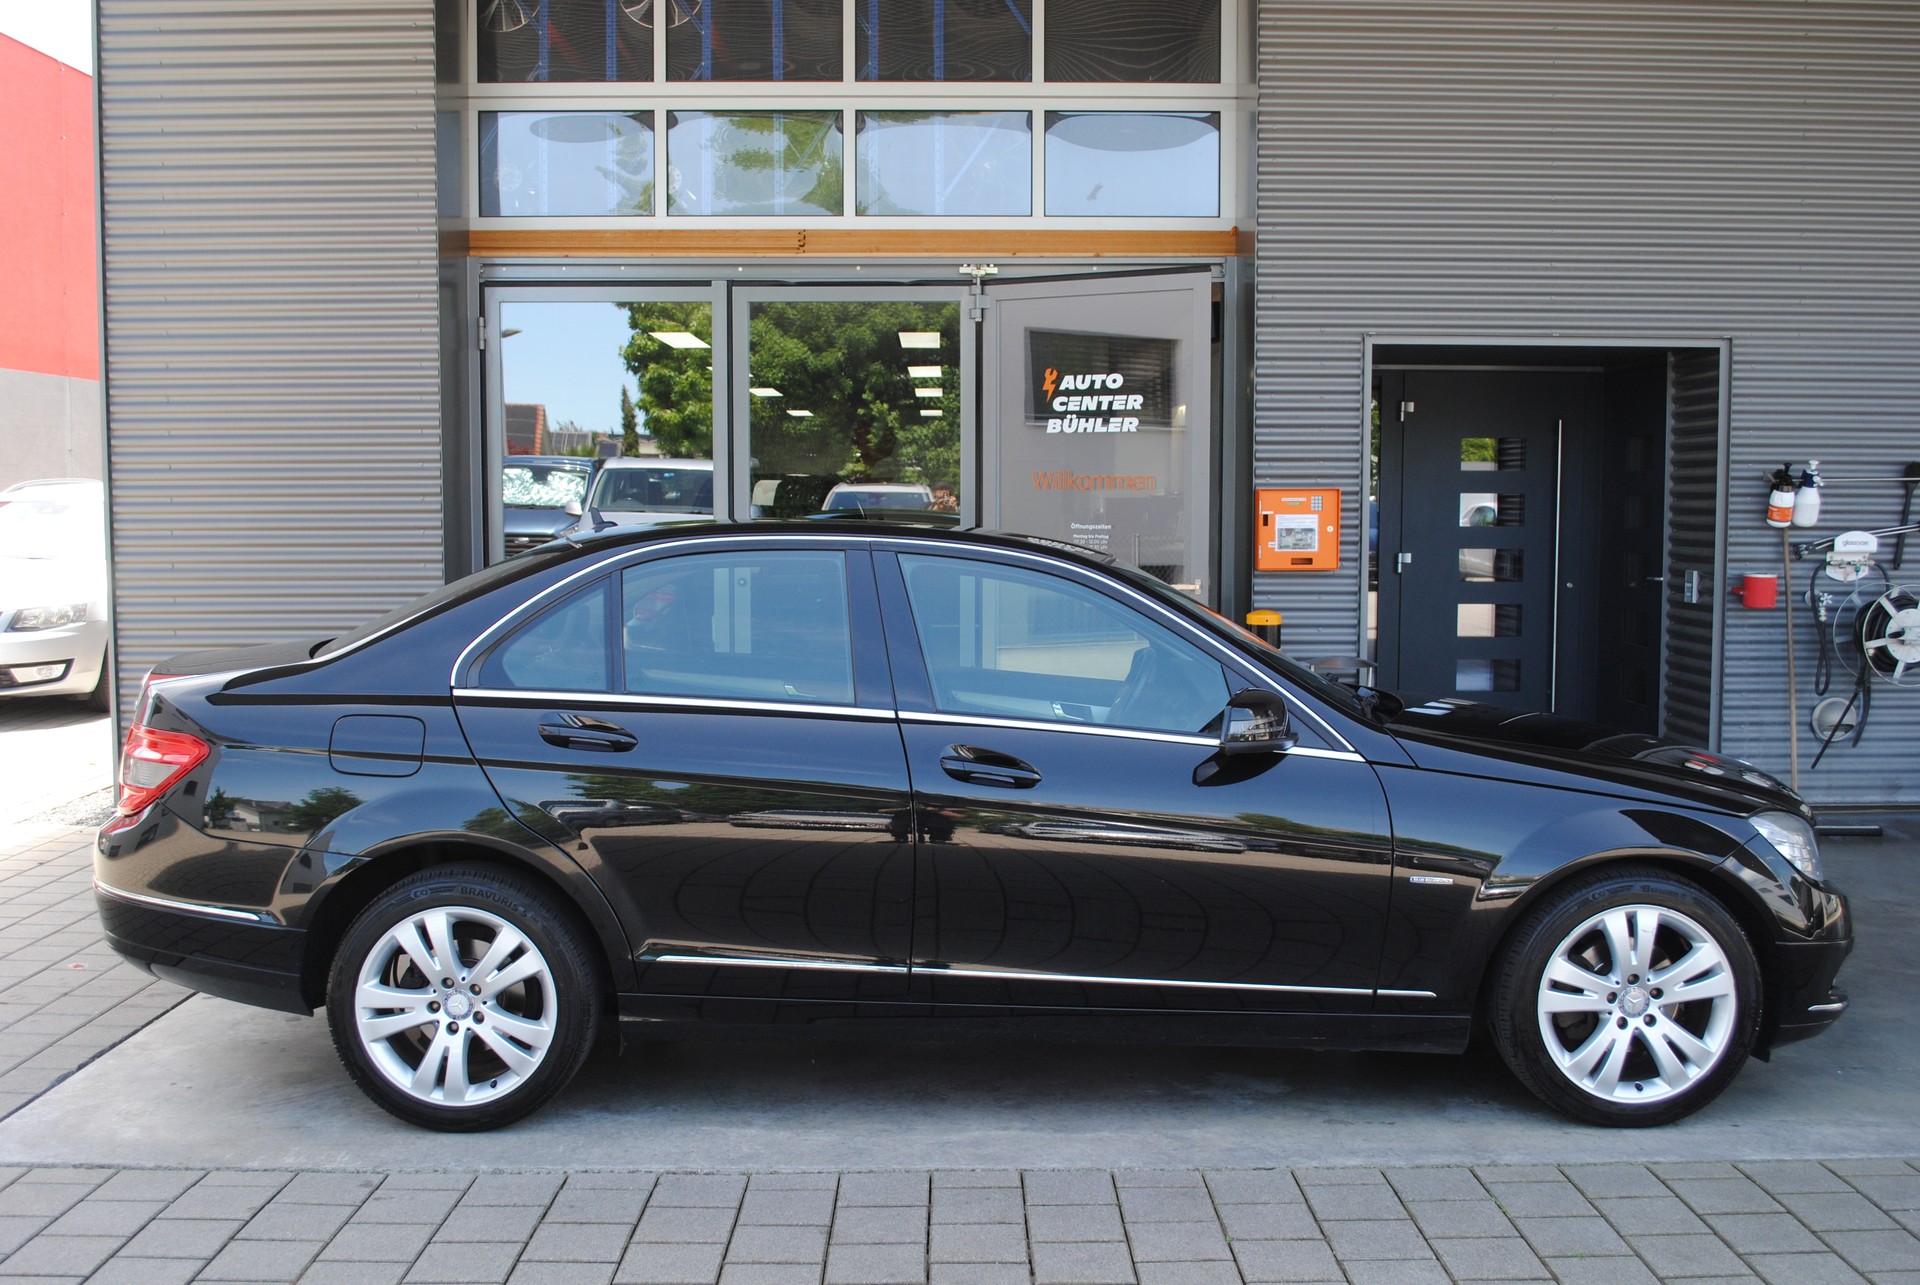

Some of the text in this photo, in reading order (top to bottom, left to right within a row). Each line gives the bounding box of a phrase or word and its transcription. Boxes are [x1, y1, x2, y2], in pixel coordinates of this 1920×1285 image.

[1059, 373, 1124, 390] AUTO
[1052, 394, 1144, 412] CENTER
[1046, 414, 1139, 433] BÜHLER
[1032, 470, 1157, 491] Willkommen
[1070, 522, 1112, 530] Öffnungszeiten
[460, 886, 519, 912] BRAVURIS
